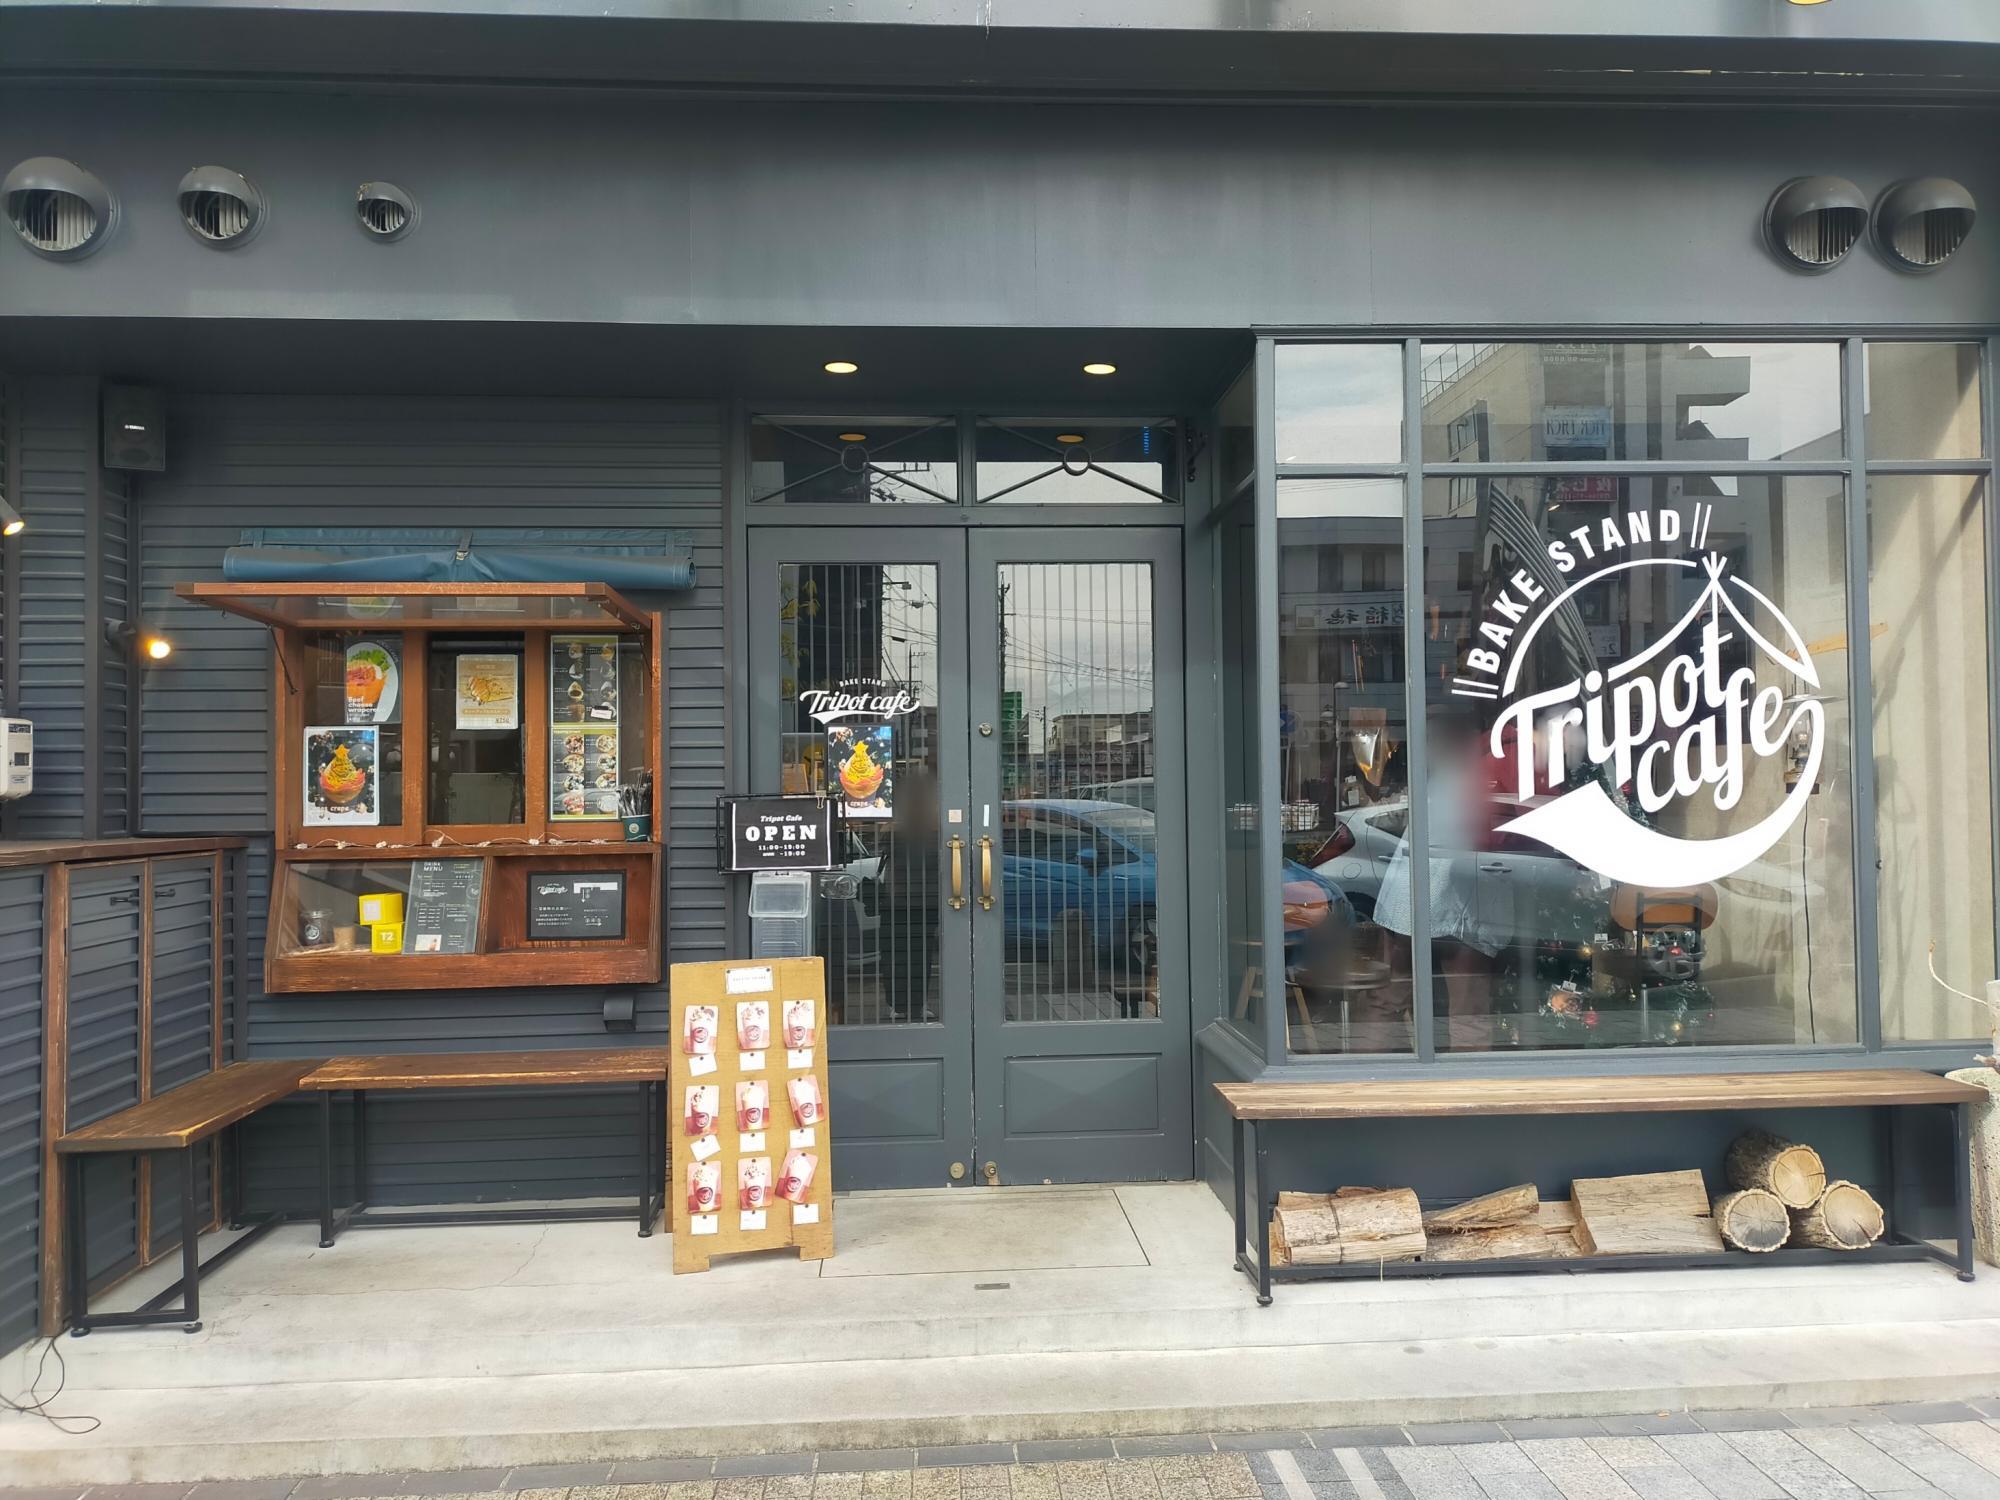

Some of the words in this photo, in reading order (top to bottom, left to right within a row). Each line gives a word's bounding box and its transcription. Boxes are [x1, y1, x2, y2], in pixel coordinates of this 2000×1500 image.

[1467, 569, 1544, 674] BAKE
[1548, 509, 1681, 573] STAND
[800, 690, 872, 715] Tripot
[869, 690, 912, 719] cafe
[839, 678, 859, 687] BAKE
[862, 678, 887, 687] STAND
[1490, 620, 1734, 803] Tripot
[1636, 667, 1784, 814] cafe
[745, 825, 817, 841] OPEN
